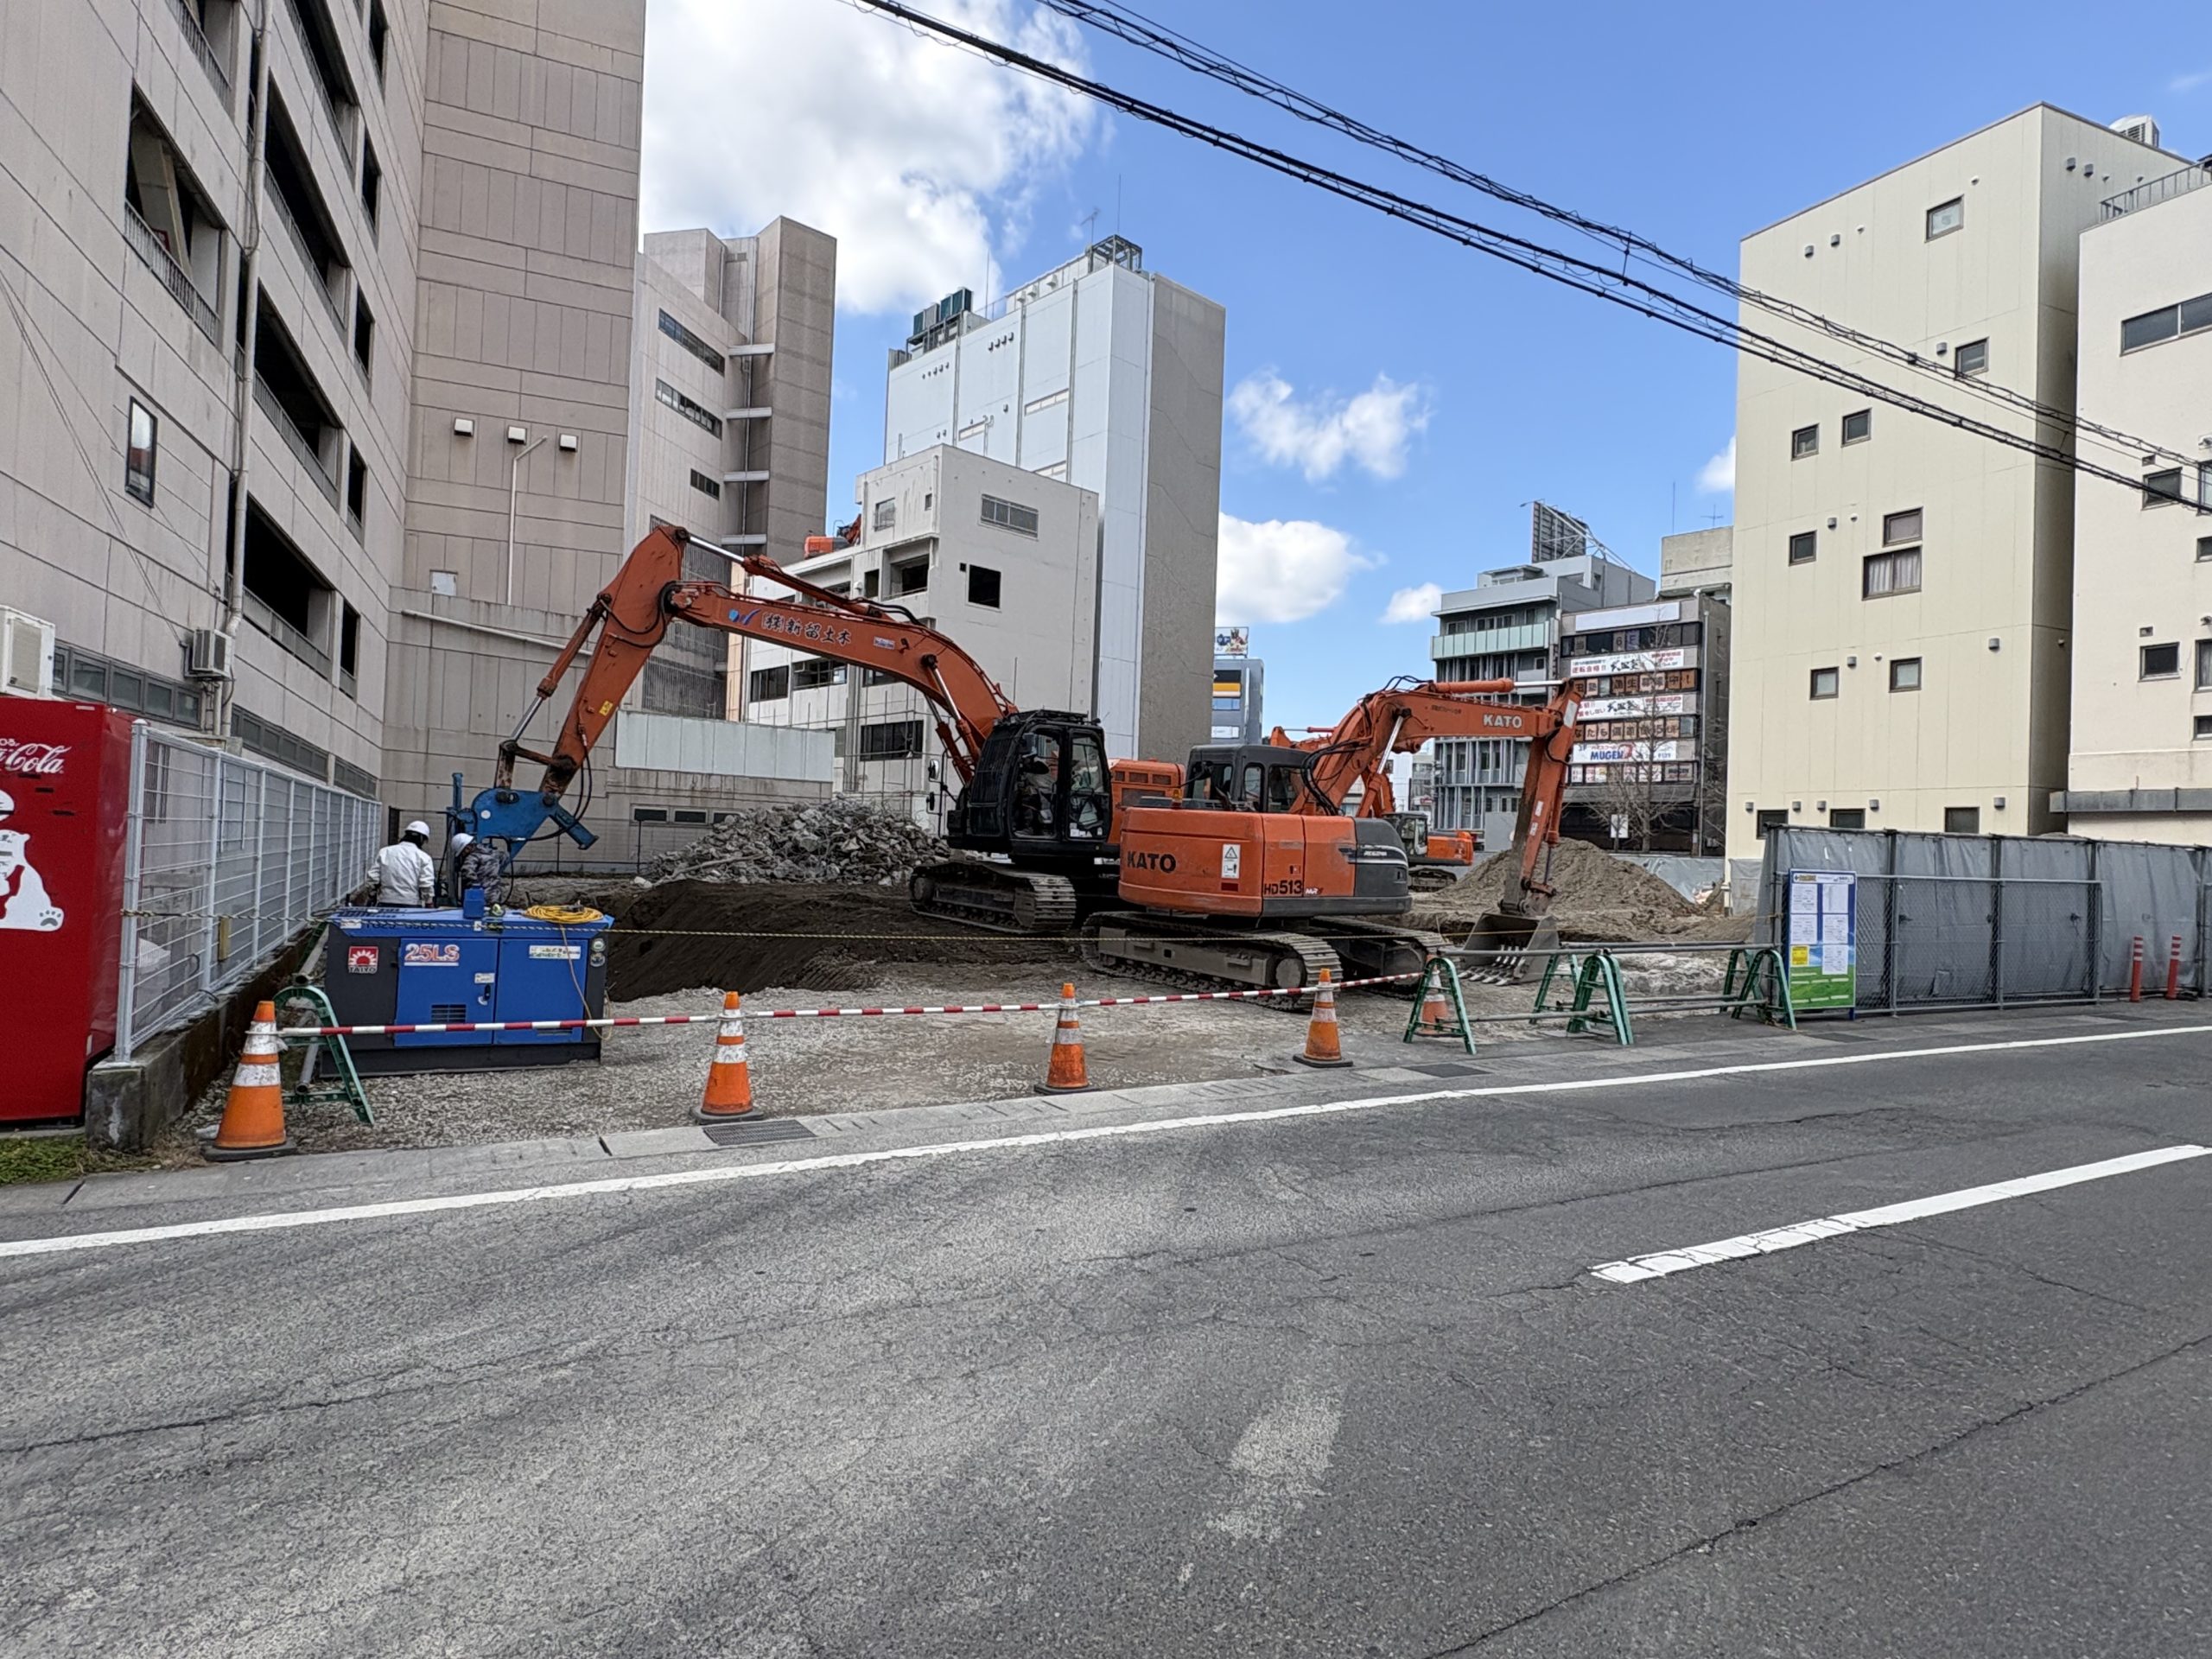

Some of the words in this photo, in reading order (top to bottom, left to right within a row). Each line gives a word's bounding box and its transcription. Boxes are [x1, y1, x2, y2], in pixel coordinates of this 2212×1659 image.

[1483, 714, 1522, 728] KATO
[1590, 749, 1624, 761] MUGEN
[1126, 850, 1178, 874] KATO
[1263, 880, 1303, 895] HD513
[404, 943, 461, 963] 25LS
[348, 965, 378, 975] TAIYO
